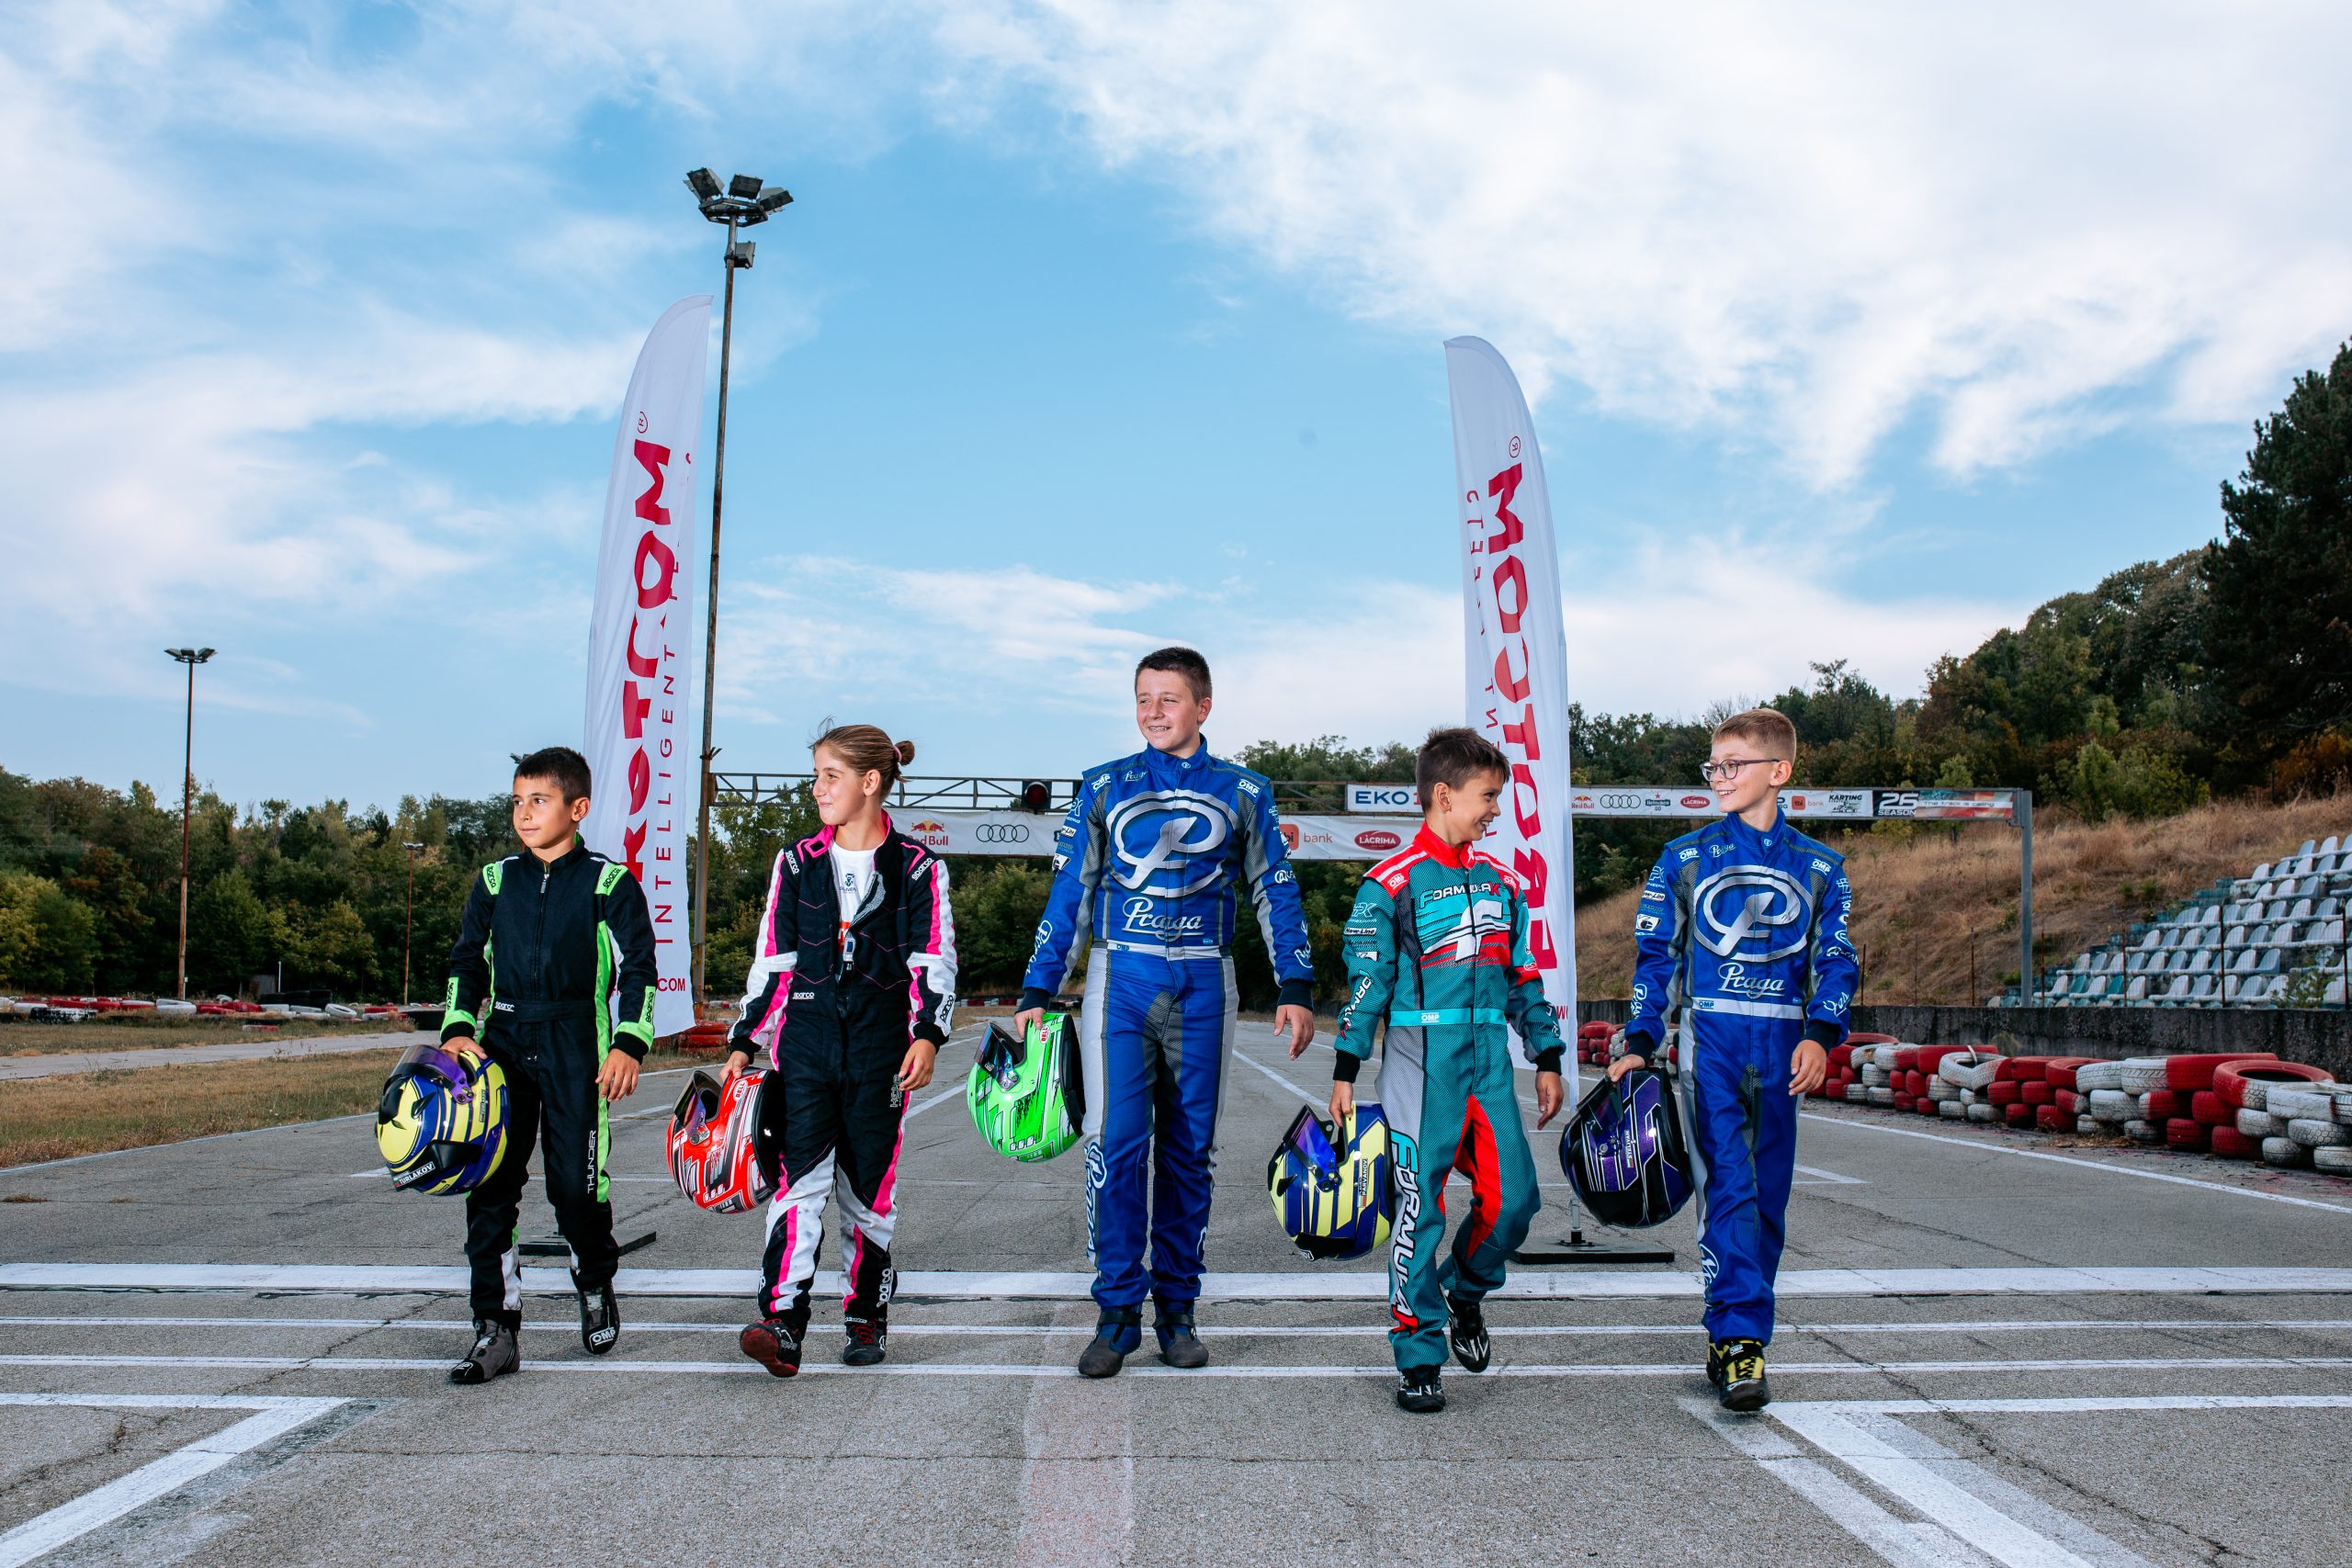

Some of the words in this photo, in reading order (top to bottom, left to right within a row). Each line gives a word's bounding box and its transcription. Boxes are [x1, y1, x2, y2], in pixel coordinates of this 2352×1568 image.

[622, 439, 675, 883] ROTCOM
[655, 644, 676, 943] INTELLIGENT
[1238, 780, 1260, 795] OMP
[1355, 791, 1409, 806] EKO
[928, 835, 949, 846] Bull
[1286, 831, 1295, 842] bi
[1304, 832, 1332, 843] bank
[786, 850, 800, 874] sparco
[1679, 849, 1699, 861] OMP
[911, 857, 935, 881] sparco
[1812, 860, 1831, 874] OMP
[603, 867, 622, 889] sparco
[1389, 874, 1406, 887] OMP
[1121, 897, 1205, 942] Praga
[1116, 943, 1130, 952] OMP
[1717, 962, 1786, 999] Praga
[792, 990, 815, 999] sparco
[645, 991, 655, 1023] sparco
[939, 994, 956, 1023] parco
[1699, 999, 1715, 1009] OMP
[1421, 1013, 1440, 1022] OMP
[735, 1083, 746, 1099] BELL
[587, 1130, 597, 1194] THUNDER
[399, 1163, 435, 1185] TURLAKOV
[592, 1328, 616, 1344] OMP
